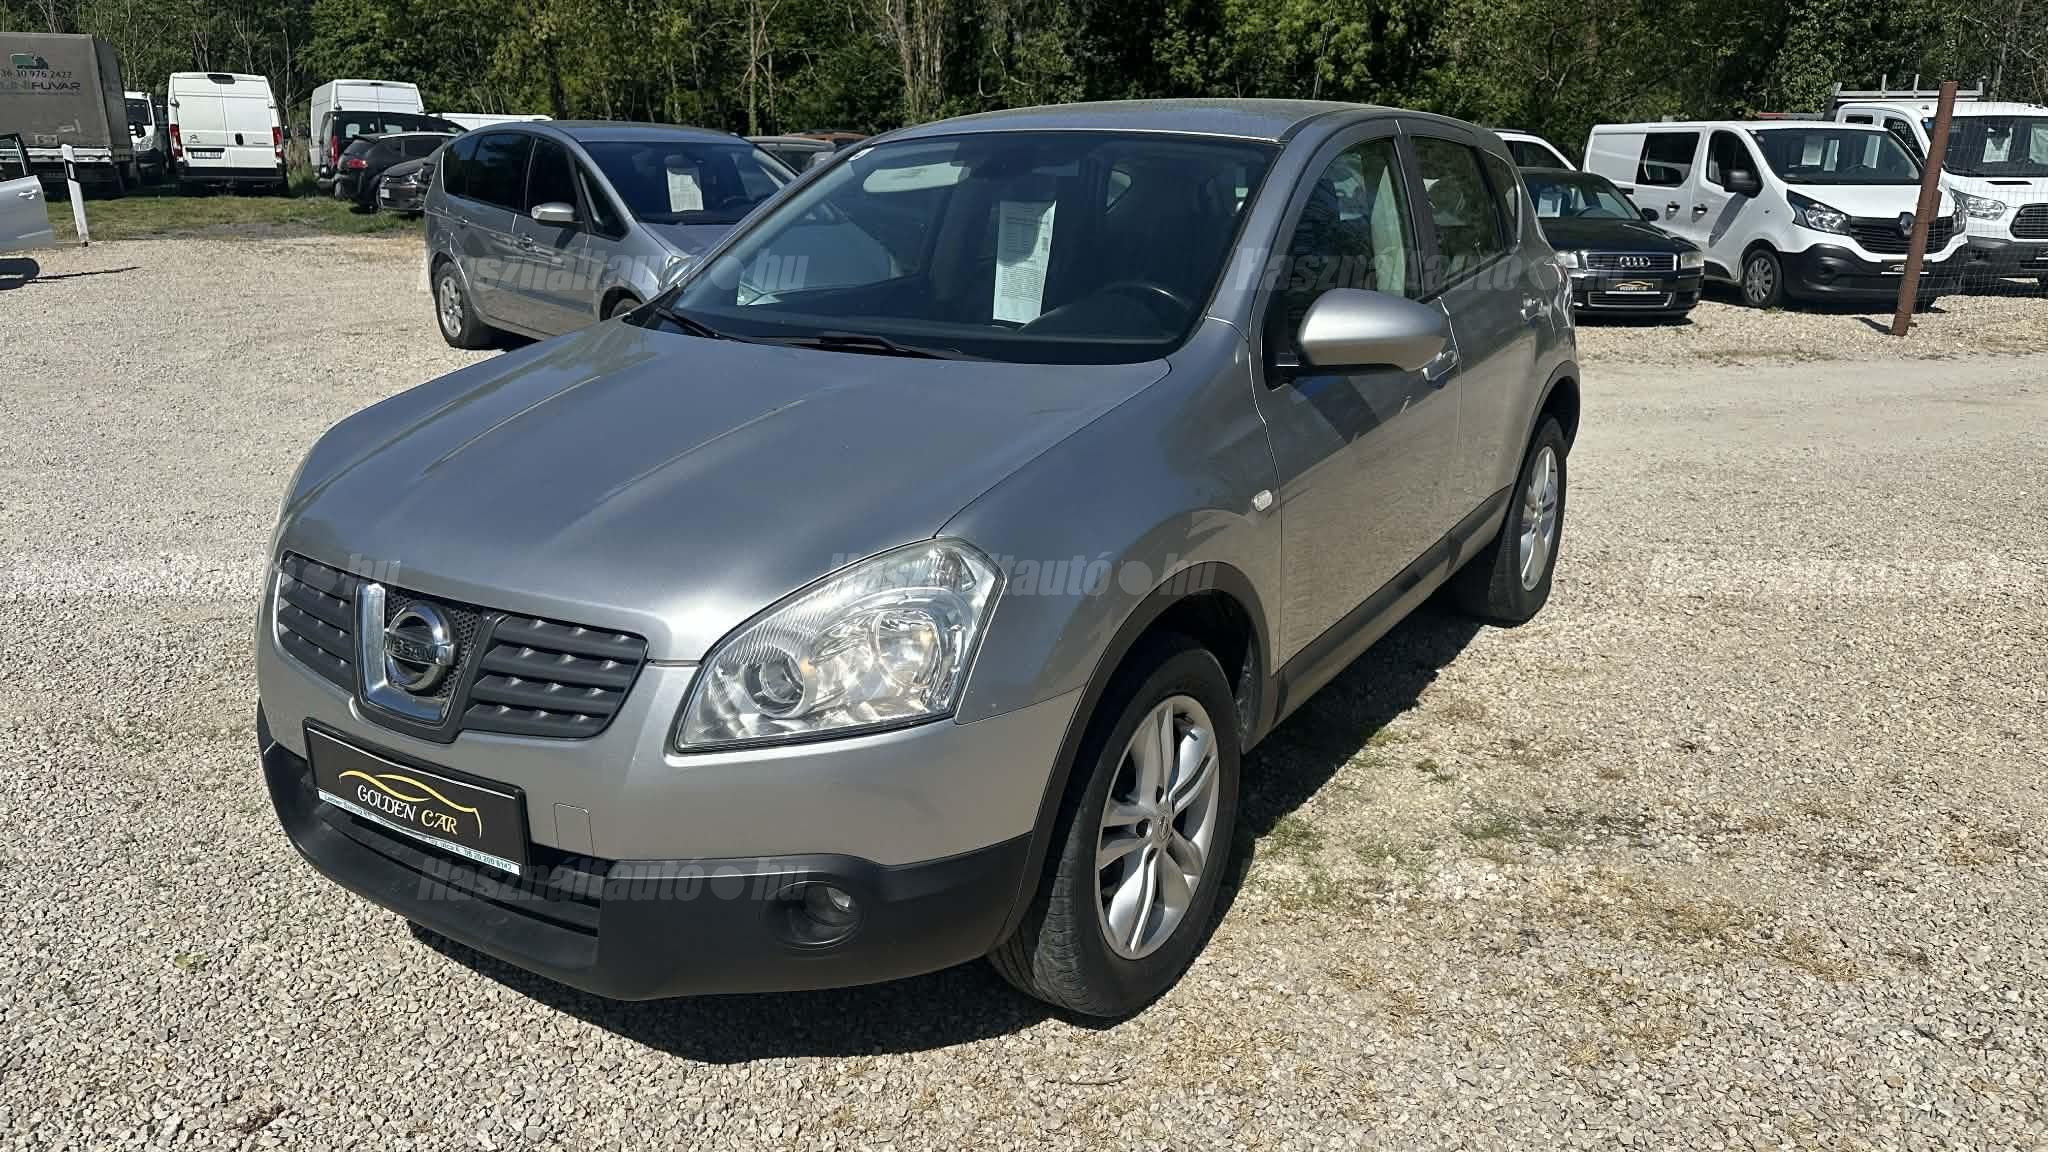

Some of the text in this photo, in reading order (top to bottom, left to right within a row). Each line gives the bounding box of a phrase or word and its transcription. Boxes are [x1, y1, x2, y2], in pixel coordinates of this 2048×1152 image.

[384, 638, 438, 660] NISSAN
[357, 784, 417, 822] GOLDEN
[421, 809, 458, 836] CAR
